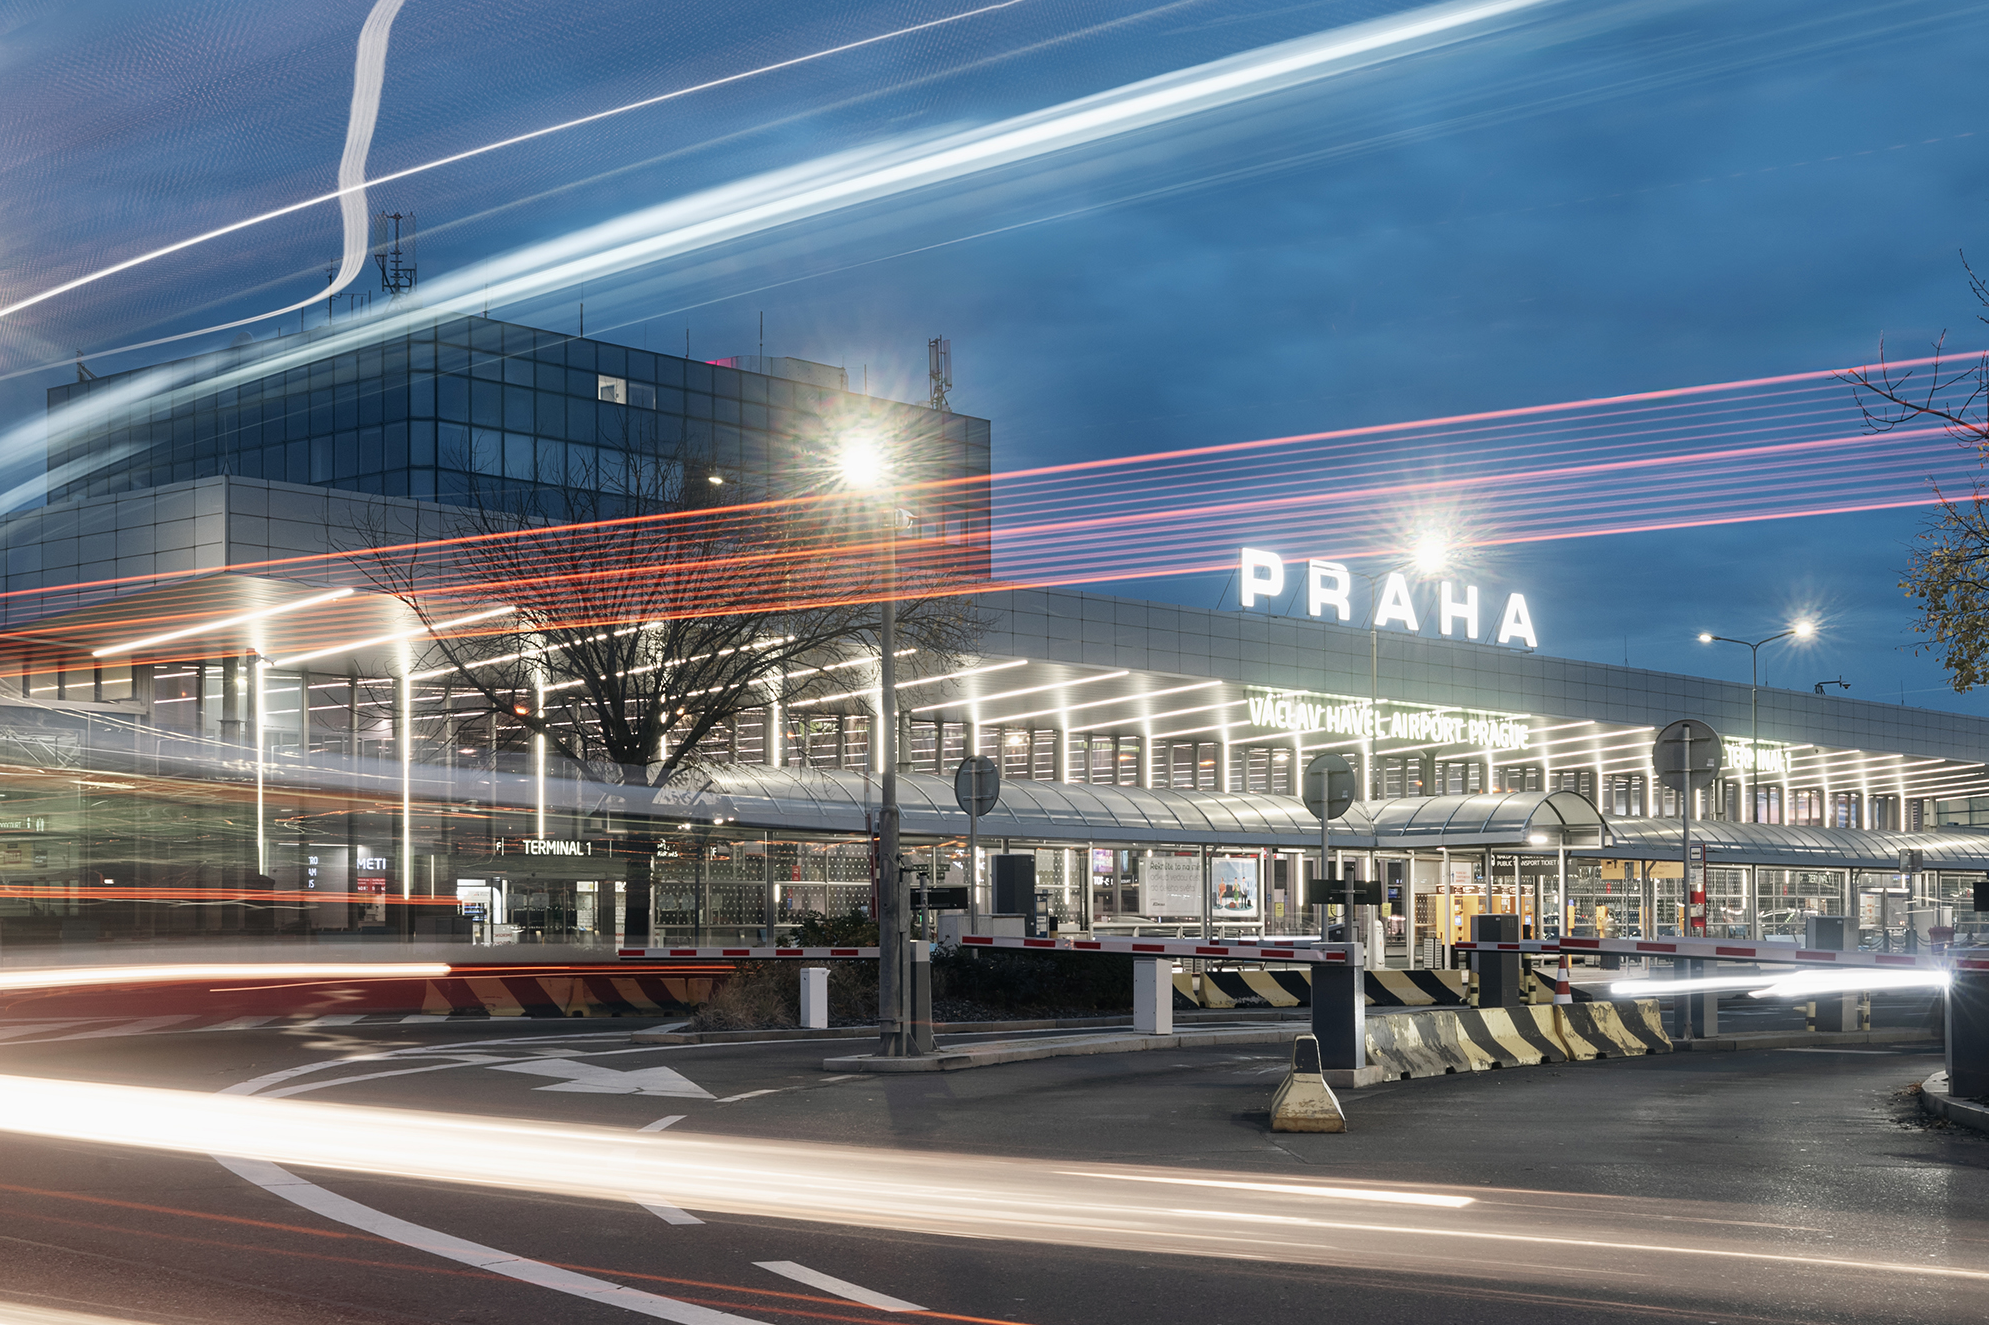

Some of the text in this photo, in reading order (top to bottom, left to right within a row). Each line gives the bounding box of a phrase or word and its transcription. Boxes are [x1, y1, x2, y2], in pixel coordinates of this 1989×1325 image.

[1240, 547, 1537, 648] PRAHA
[1249, 693, 1529, 750] VÁCLAV HAVEL AIRPORT PRAGUE
[523, 840, 592, 856] TERMINAL 1
